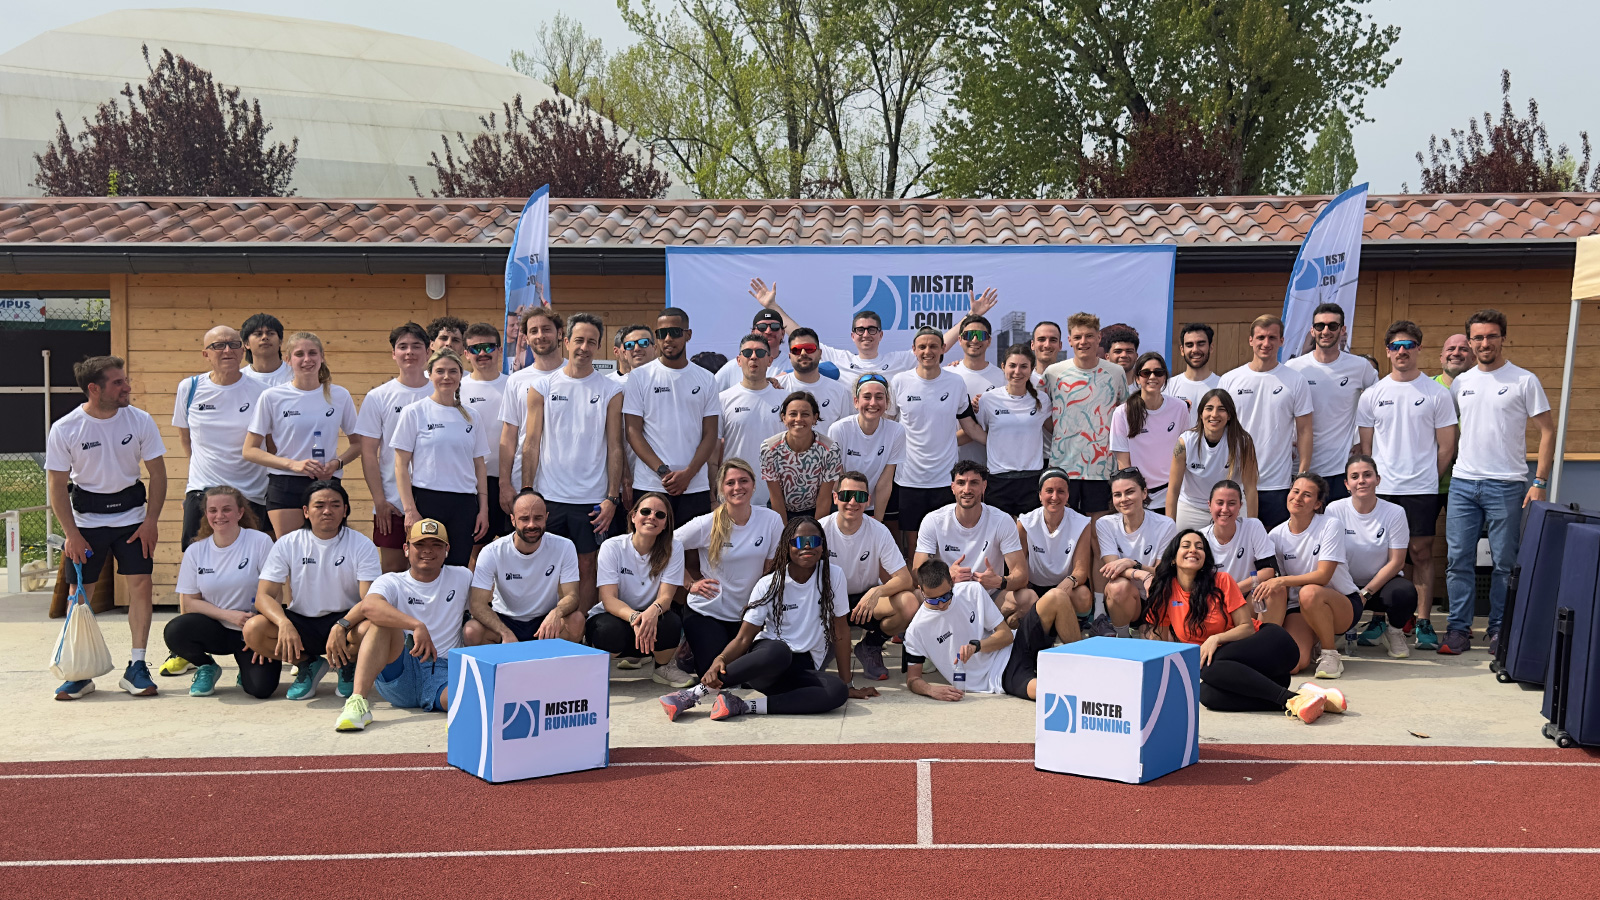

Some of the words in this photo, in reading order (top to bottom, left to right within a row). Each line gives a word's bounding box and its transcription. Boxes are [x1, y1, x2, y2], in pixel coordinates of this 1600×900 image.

[911, 275, 973, 292] MISTER
[911, 294, 982, 311] RUNNIN
[911, 312, 953, 329] .COM
[545, 699, 588, 716] MISTER
[1081, 701, 1122, 718] MISTER
[544, 712, 597, 731] RUNNING
[1081, 716, 1130, 734] RUNNING
